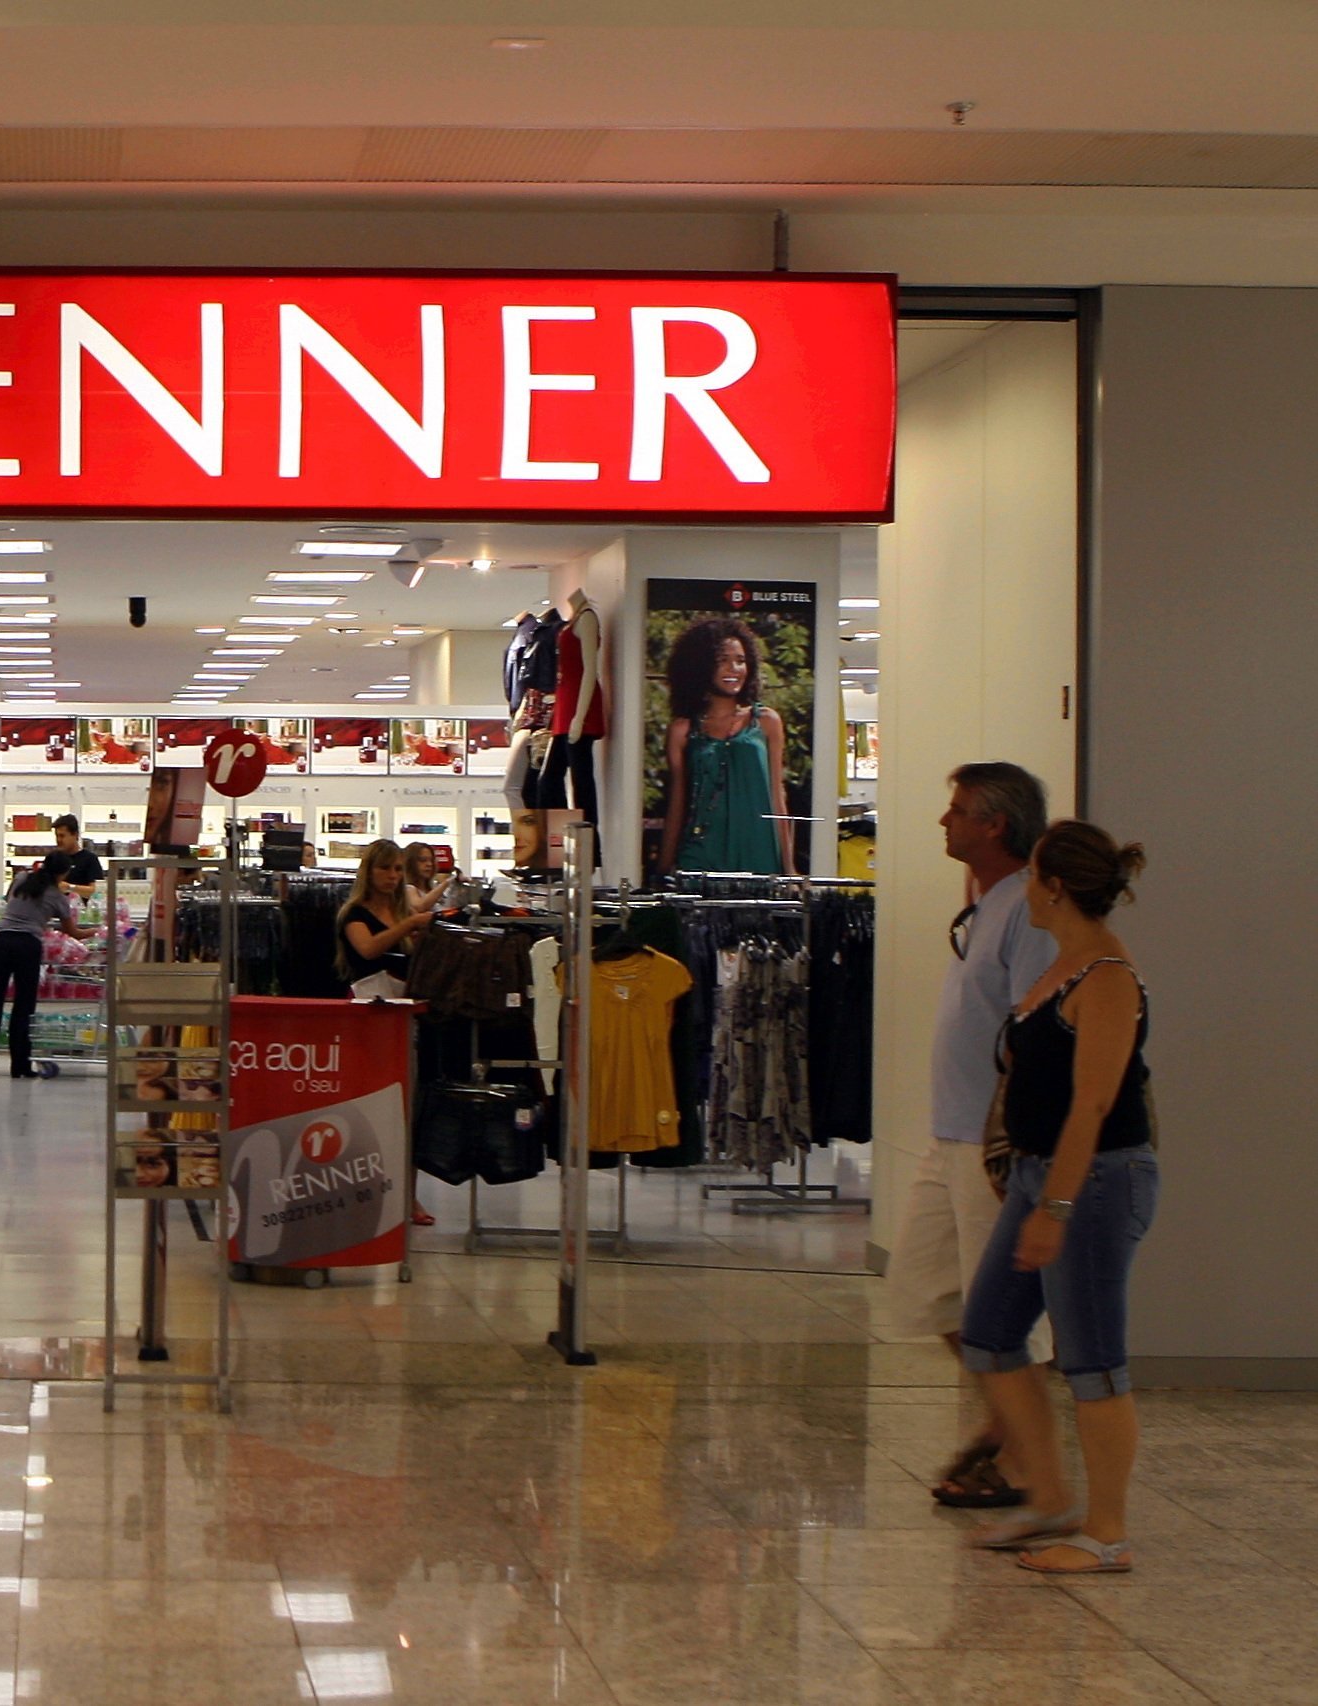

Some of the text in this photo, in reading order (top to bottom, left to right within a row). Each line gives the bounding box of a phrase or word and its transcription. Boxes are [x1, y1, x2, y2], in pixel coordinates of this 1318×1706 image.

[751, 591, 812, 603] BLUE STEEL
[212, 743, 257, 784] r
[228, 1035, 341, 1080] ça aqui
[293, 1079, 341, 1093] o seu
[268, 1152, 386, 1207] RENNER
